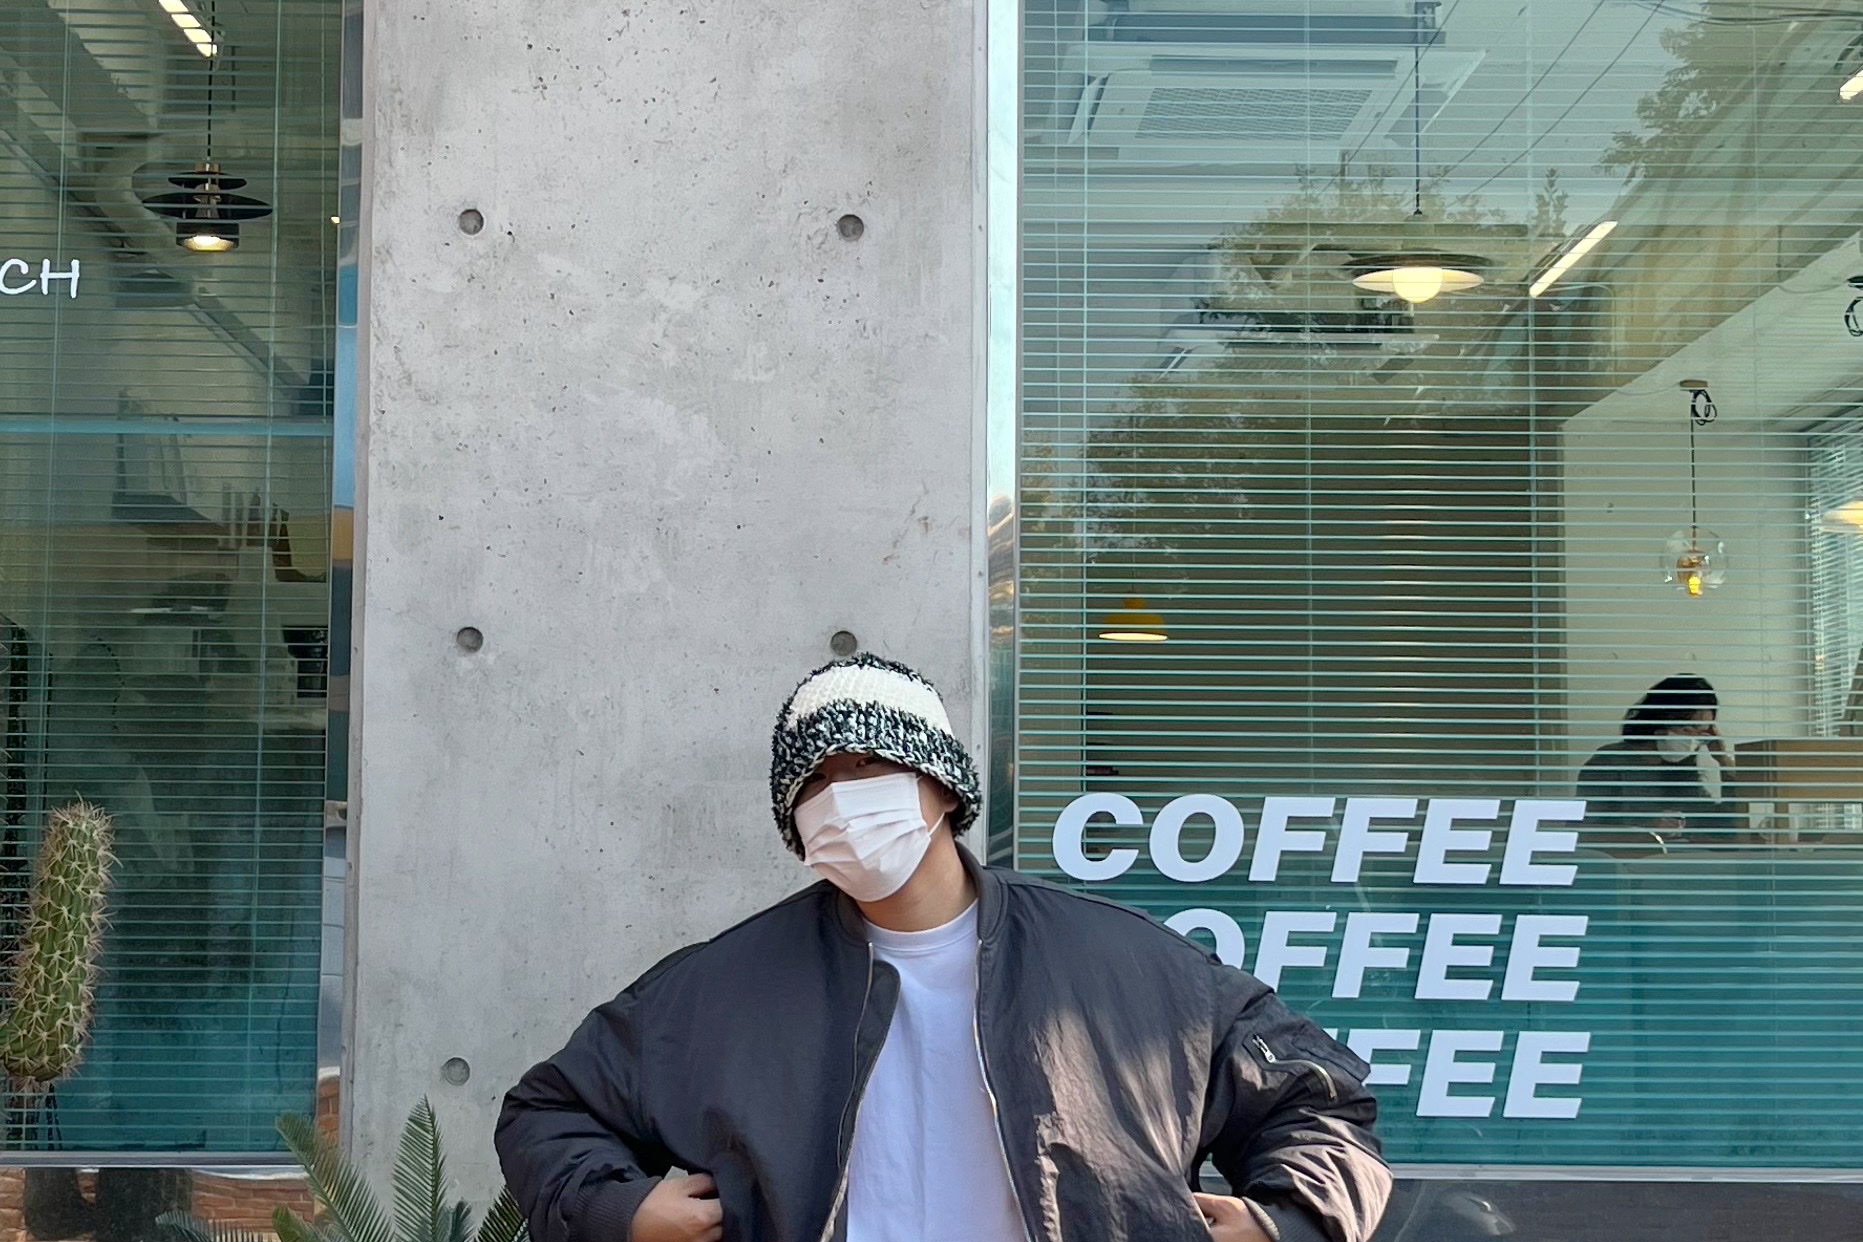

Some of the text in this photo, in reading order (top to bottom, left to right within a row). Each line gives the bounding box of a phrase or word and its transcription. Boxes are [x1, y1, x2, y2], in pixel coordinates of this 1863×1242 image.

[0, 258, 80, 299] CH
[1052, 792, 1587, 886] COFFEE
[1322, 1028, 1591, 1118] FEE
